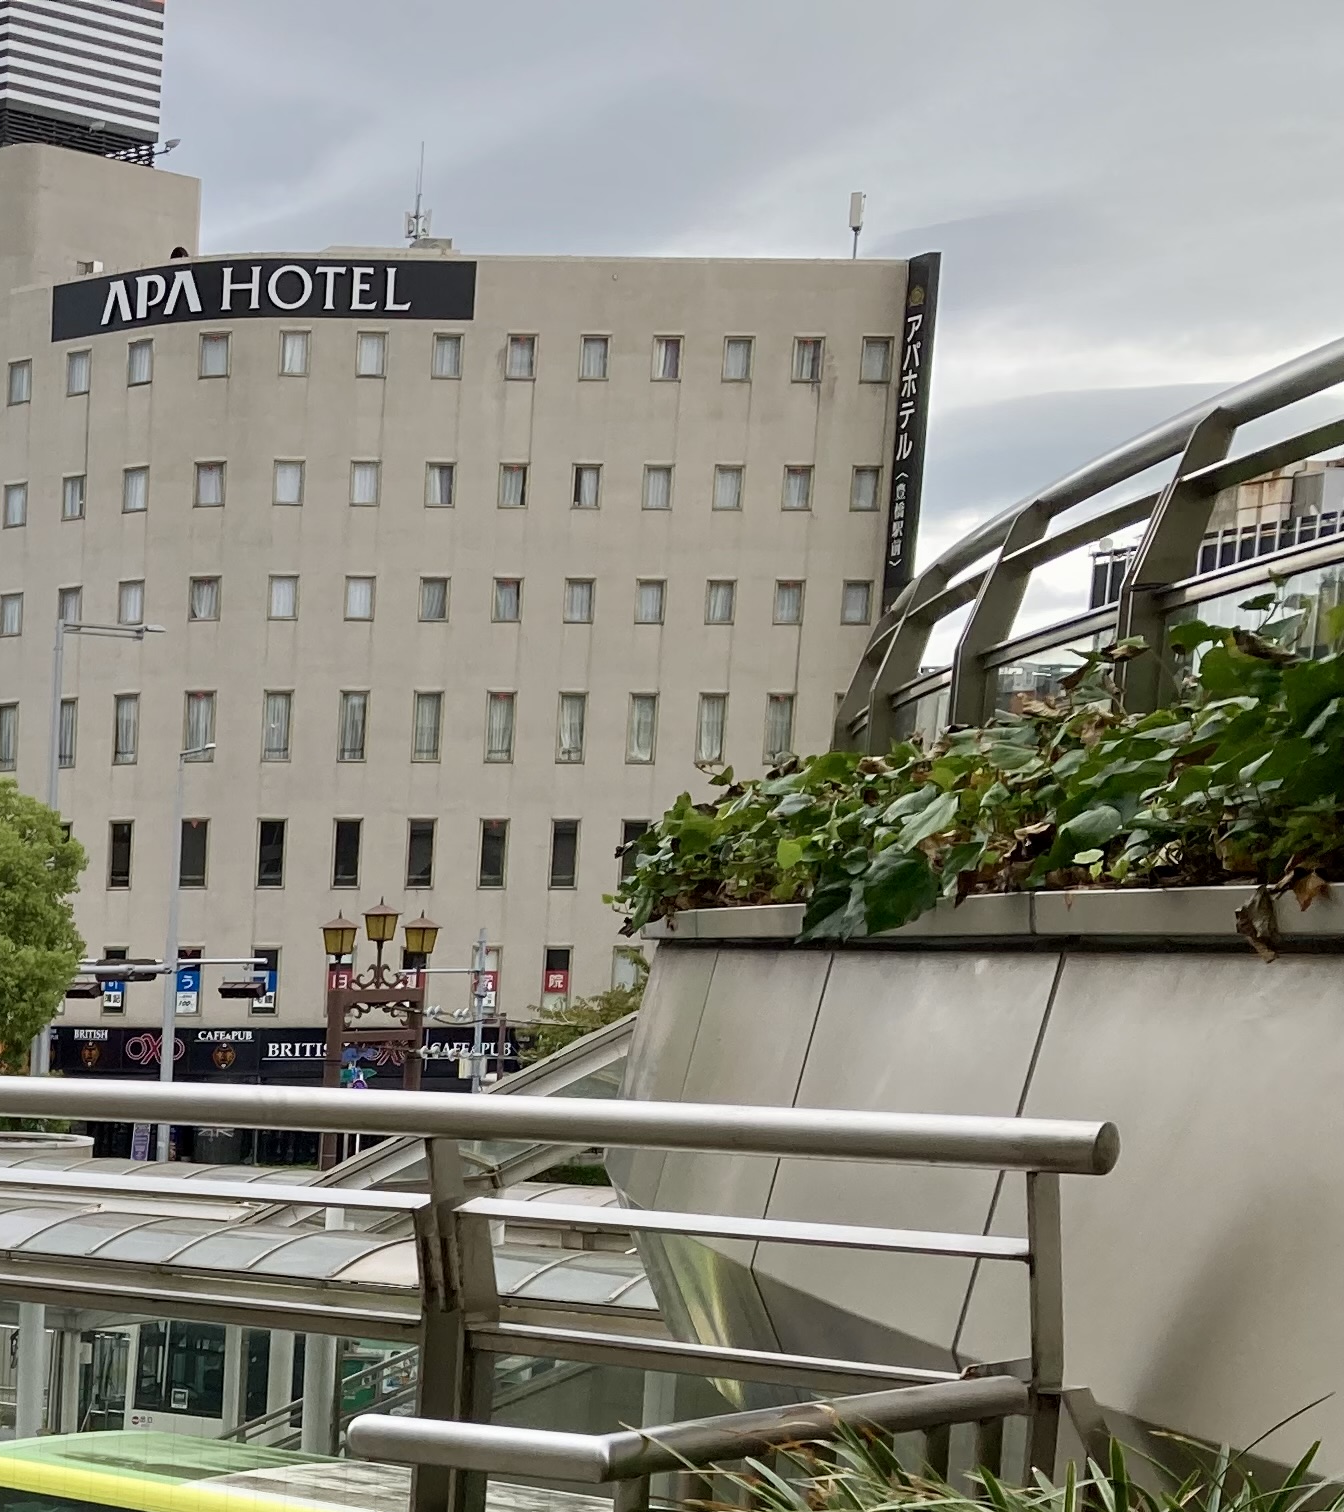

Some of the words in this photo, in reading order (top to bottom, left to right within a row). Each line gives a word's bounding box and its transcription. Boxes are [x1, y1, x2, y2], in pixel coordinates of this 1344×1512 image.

[100, 269, 203, 326] APA
[220, 264, 412, 312] HOTEL
[895, 313, 923, 461] アパホテル
[73, 1028, 109, 1040] BRITISH
[267, 1042, 329, 1058] BRITIS
